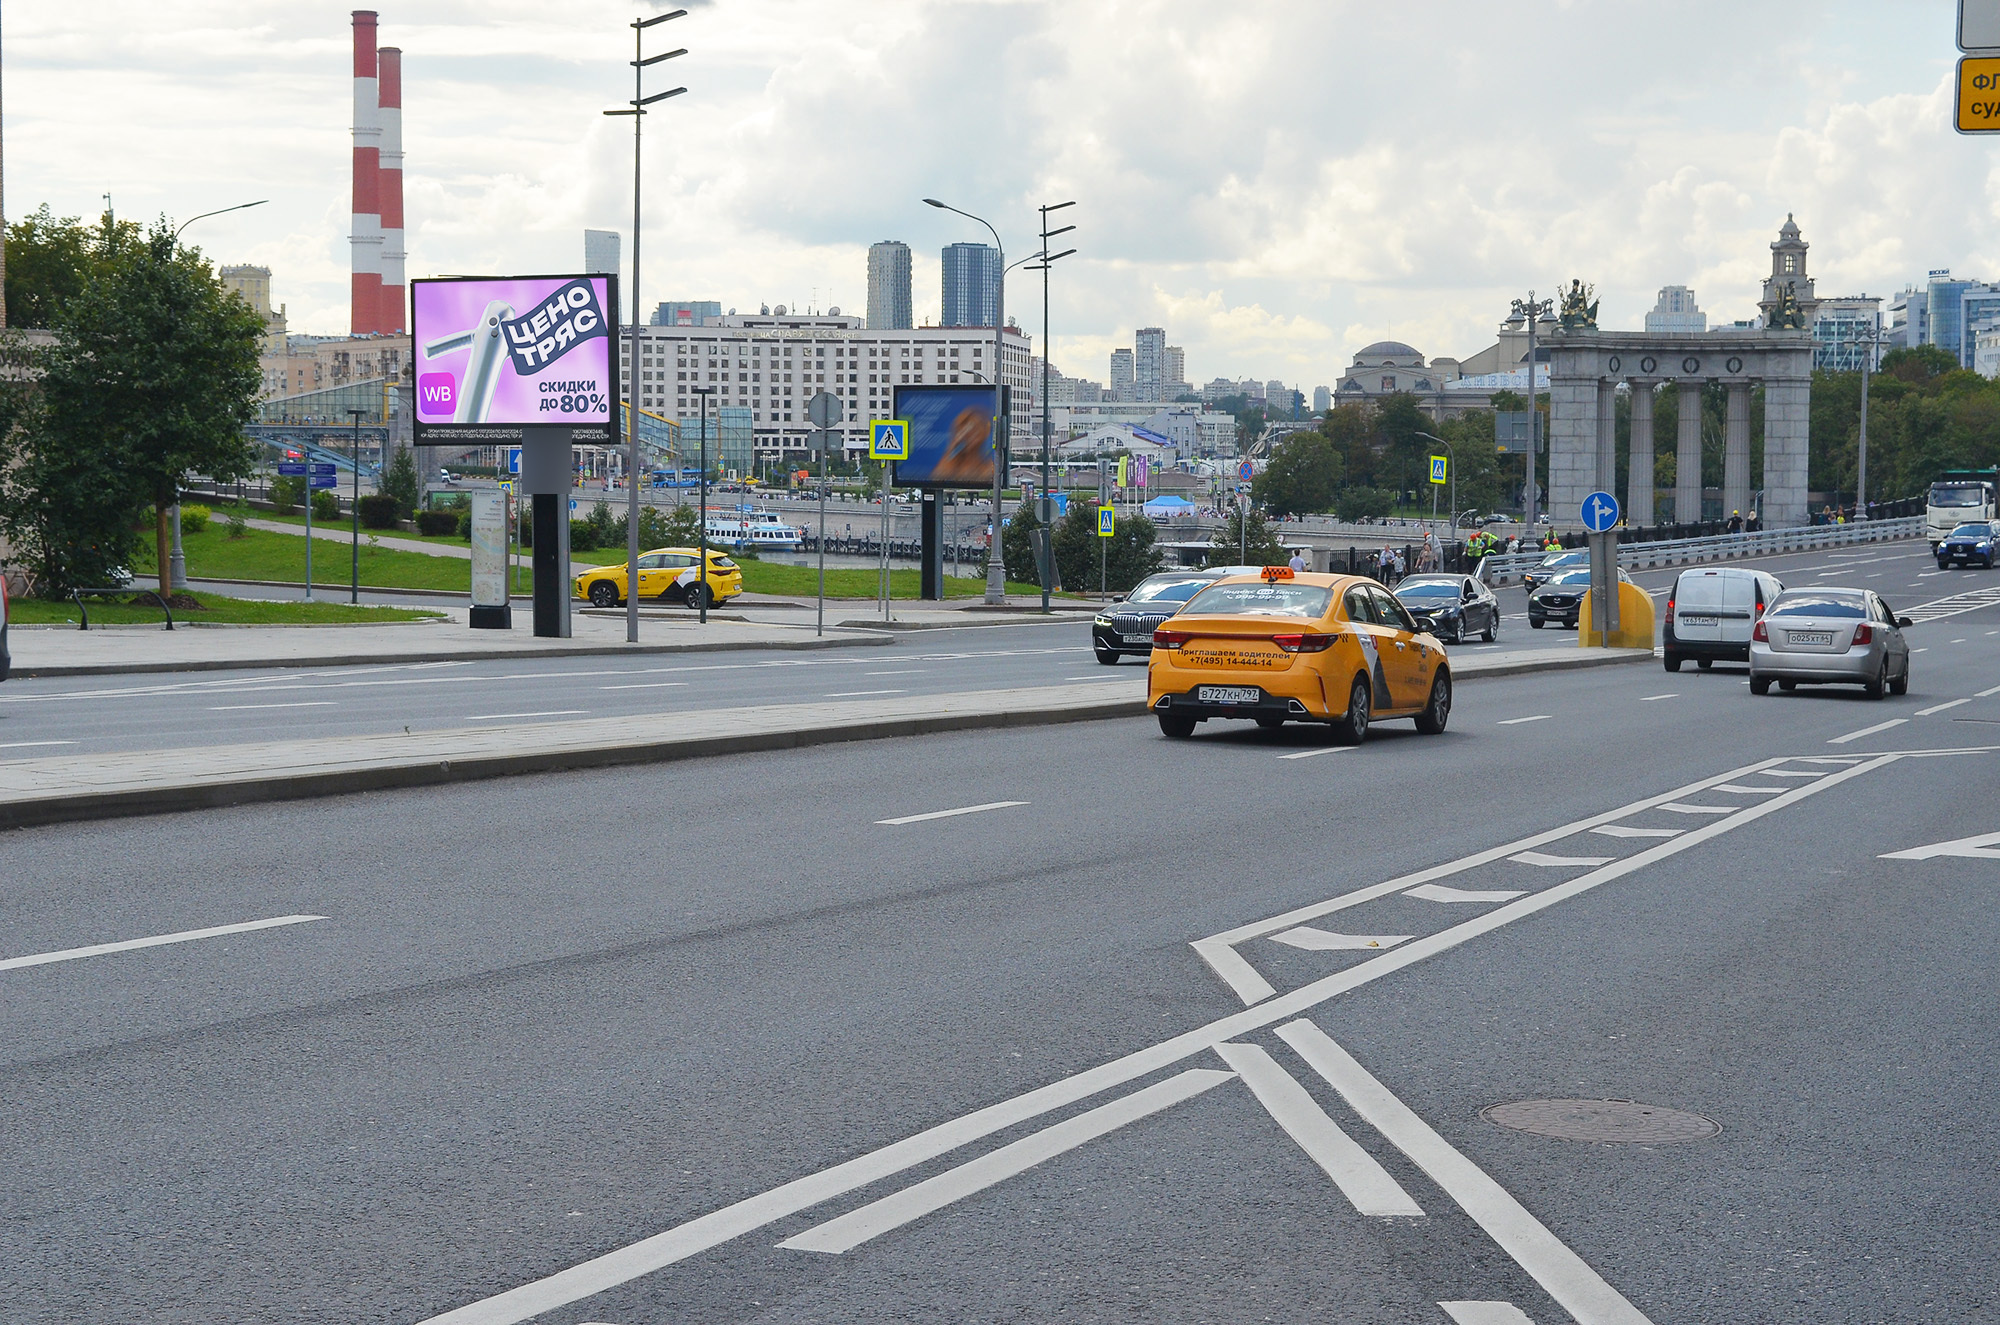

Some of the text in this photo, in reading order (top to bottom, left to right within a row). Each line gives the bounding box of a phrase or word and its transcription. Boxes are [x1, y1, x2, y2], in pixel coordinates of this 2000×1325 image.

[508, 286, 591, 345] ЦЕНО
[515, 309, 598, 367] ТРЯС
[424, 386, 451, 402] WB
[560, 394, 607, 413] 80%
[1177, 648, 1291, 660] Приглашаем водителей
[1190, 656, 1272, 667] +7(495) 14-444-14
[1202, 688, 1256, 700] В727КН 797
